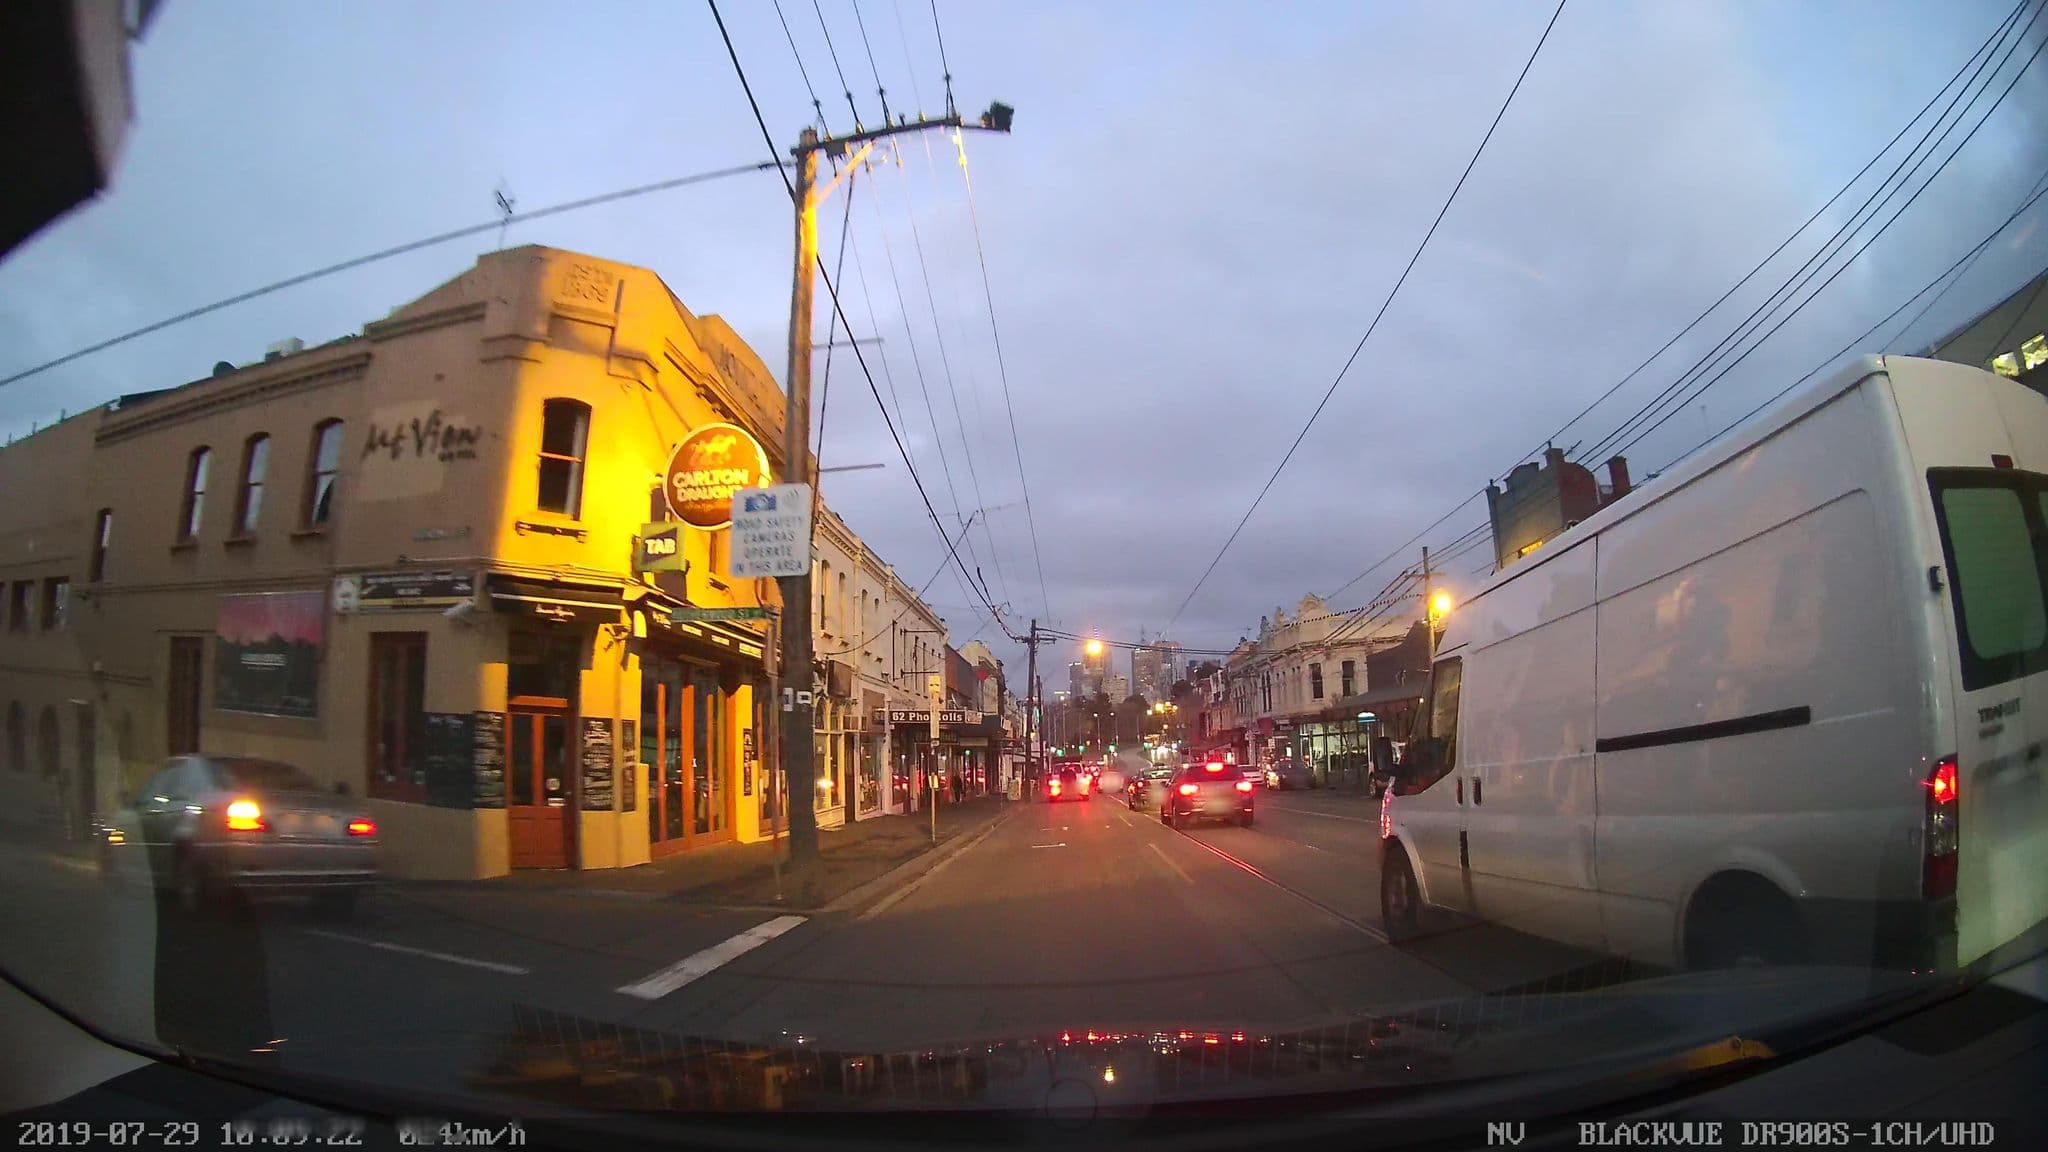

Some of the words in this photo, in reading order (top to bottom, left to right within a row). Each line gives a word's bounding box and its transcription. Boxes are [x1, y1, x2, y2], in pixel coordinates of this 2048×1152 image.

[672, 469, 749, 488] CARLTON
[644, 538, 676, 556] TAB
[892, 712, 907, 722] 62
[909, 712, 930, 722] Pho
[938, 712, 963, 722] olls
